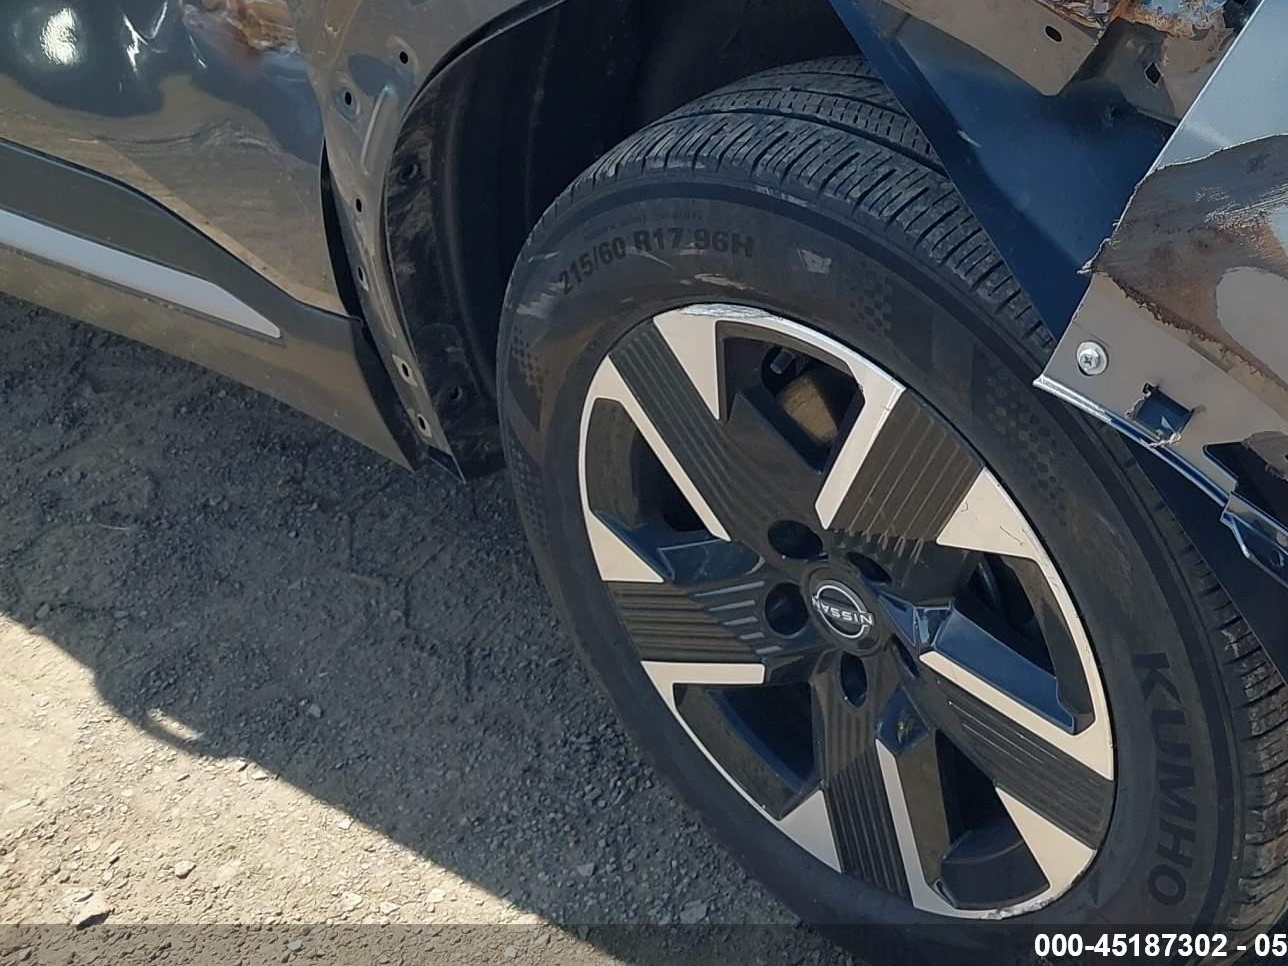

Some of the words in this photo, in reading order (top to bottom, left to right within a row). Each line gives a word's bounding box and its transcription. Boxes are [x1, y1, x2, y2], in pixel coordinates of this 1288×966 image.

[558, 235, 627, 296] 215/60
[633, 227, 685, 252] R17
[694, 228, 756, 258] 96H
[811, 595, 873, 625] NISSAN
[1130, 652, 1197, 906] KUMHO
